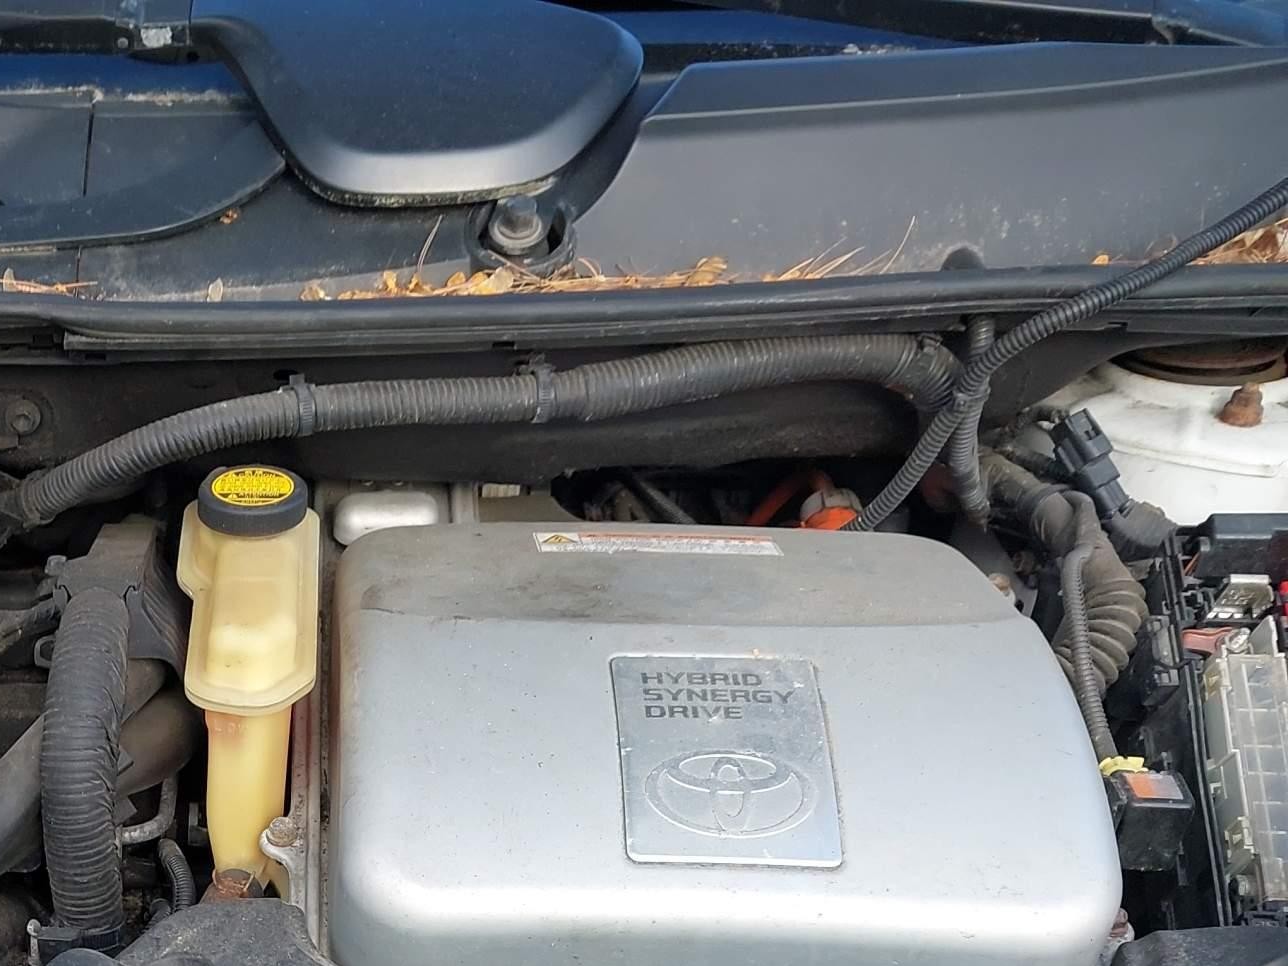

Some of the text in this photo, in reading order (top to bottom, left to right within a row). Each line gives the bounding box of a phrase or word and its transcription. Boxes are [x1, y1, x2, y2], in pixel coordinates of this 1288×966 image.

[640, 672, 762, 686] HYBRID
[643, 688, 795, 704] SYNERGY
[645, 705, 743, 719] DRIVE
